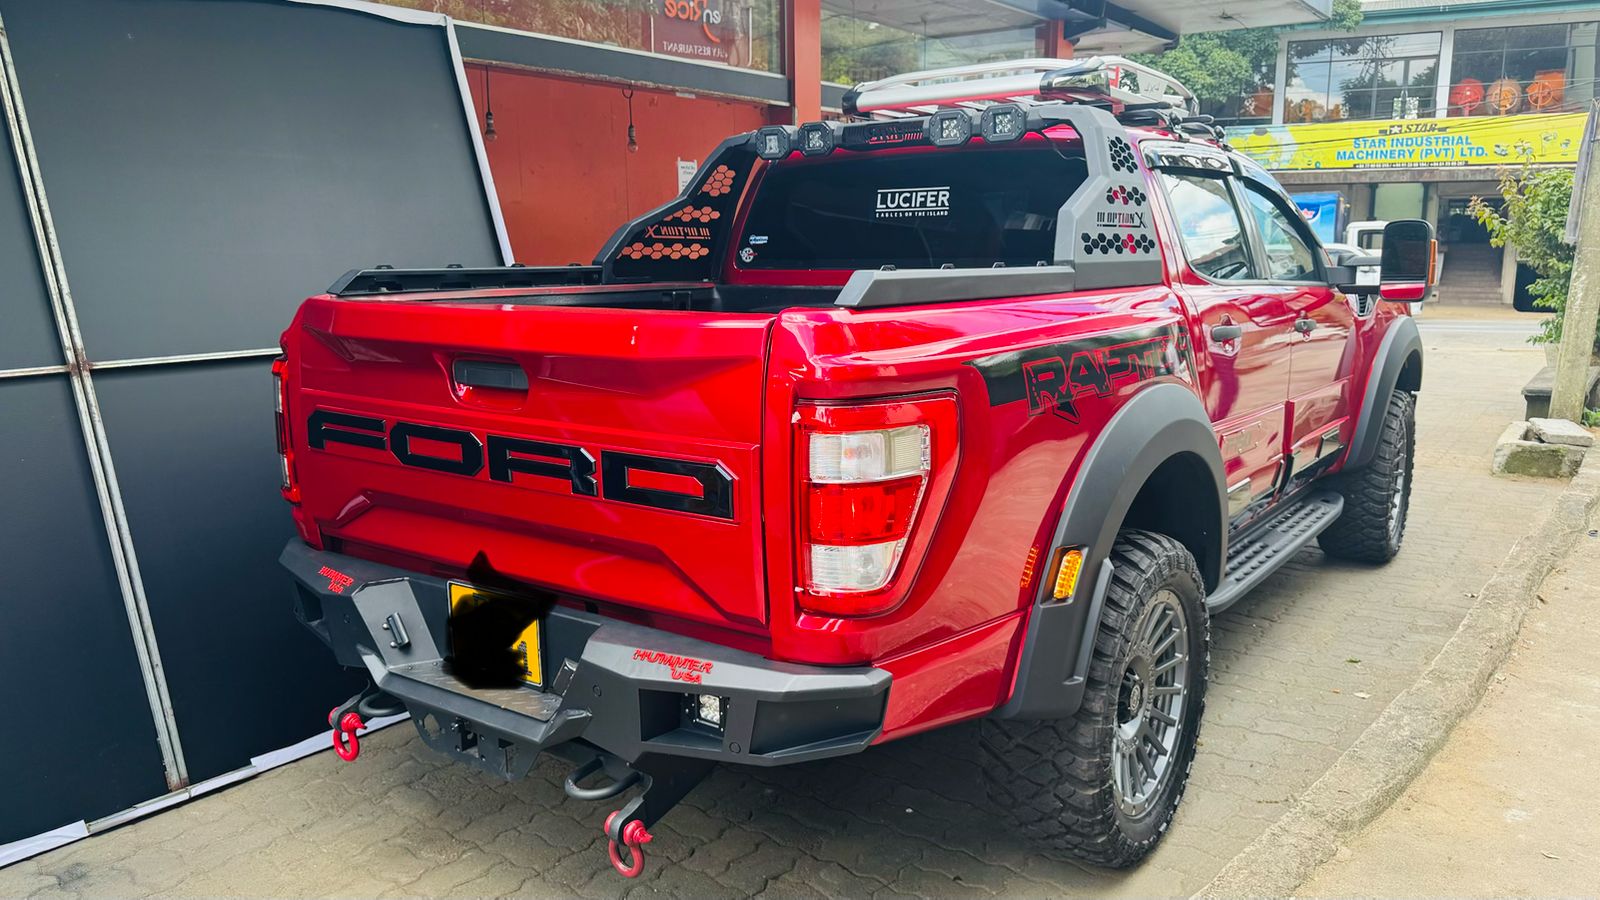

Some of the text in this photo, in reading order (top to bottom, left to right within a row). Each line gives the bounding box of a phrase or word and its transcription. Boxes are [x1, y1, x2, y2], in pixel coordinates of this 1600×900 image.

[1404, 123, 1438, 134] STAR
[1353, 135, 1472, 149] STAR INDUSTRIAL
[1336, 147, 1488, 161] MACHINERY (PVT) LTD.
[876, 190, 950, 209] LUCIFER
[307, 410, 737, 520] FORD
[671, 669, 703, 685] USA
